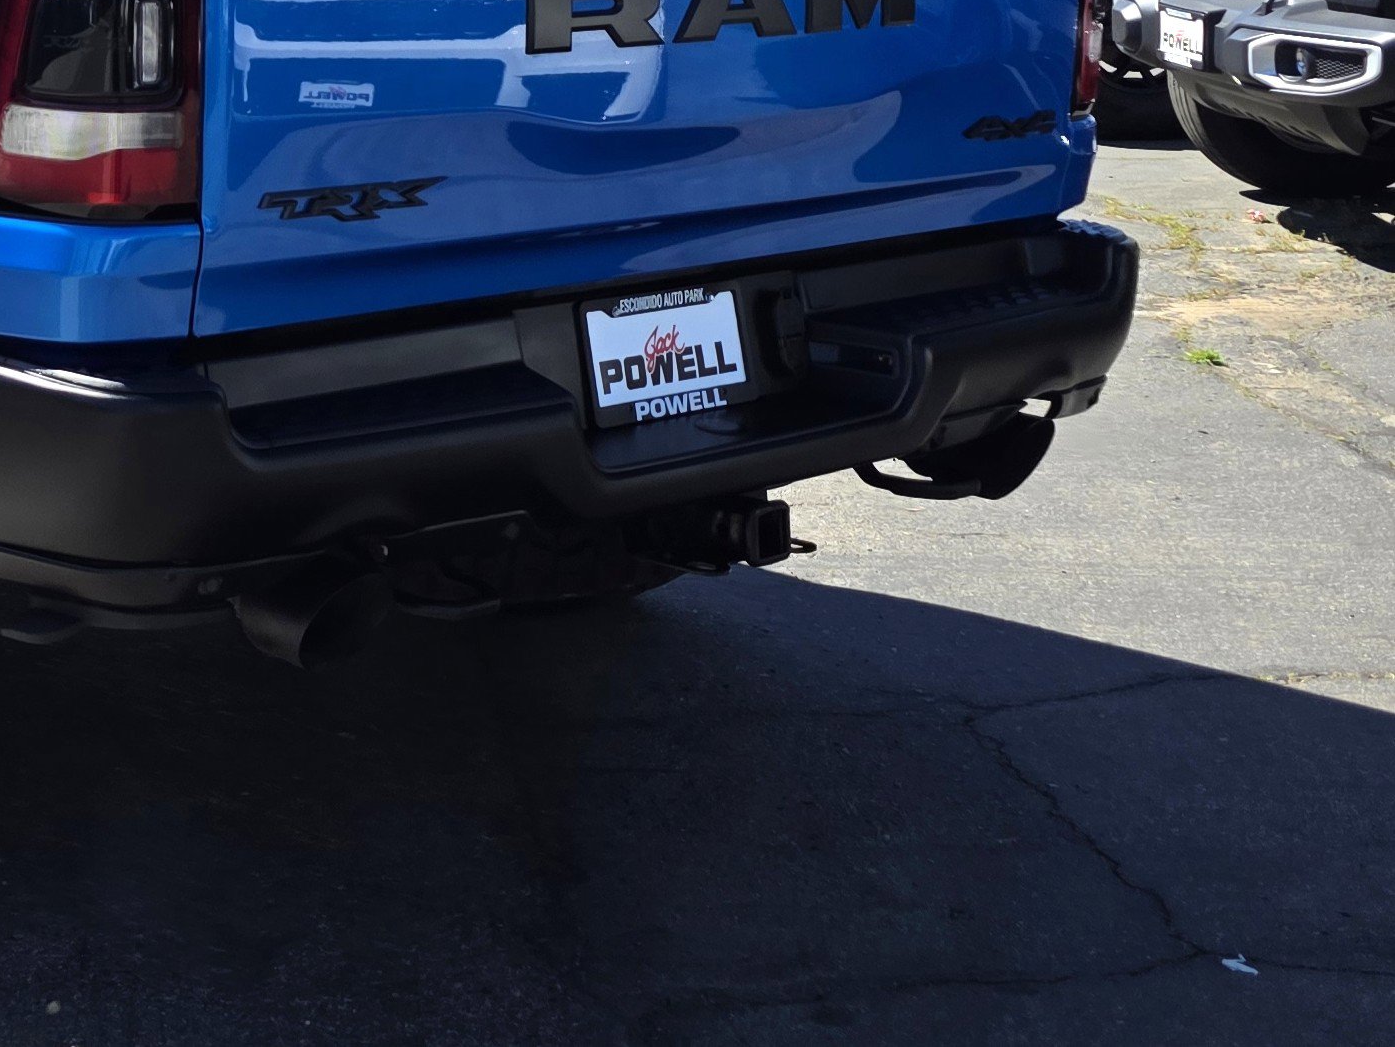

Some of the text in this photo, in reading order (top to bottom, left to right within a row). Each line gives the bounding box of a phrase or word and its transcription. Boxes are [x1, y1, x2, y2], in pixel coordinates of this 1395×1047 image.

[1163, 32, 1204, 55] POWELL
[257, 175, 449, 222] TRX
[619, 287, 704, 313] ESCONDIDO AUTO PARK
[598, 341, 737, 395] POWELL
[643, 324, 685, 374] Jack
[634, 388, 727, 421] POWELL
